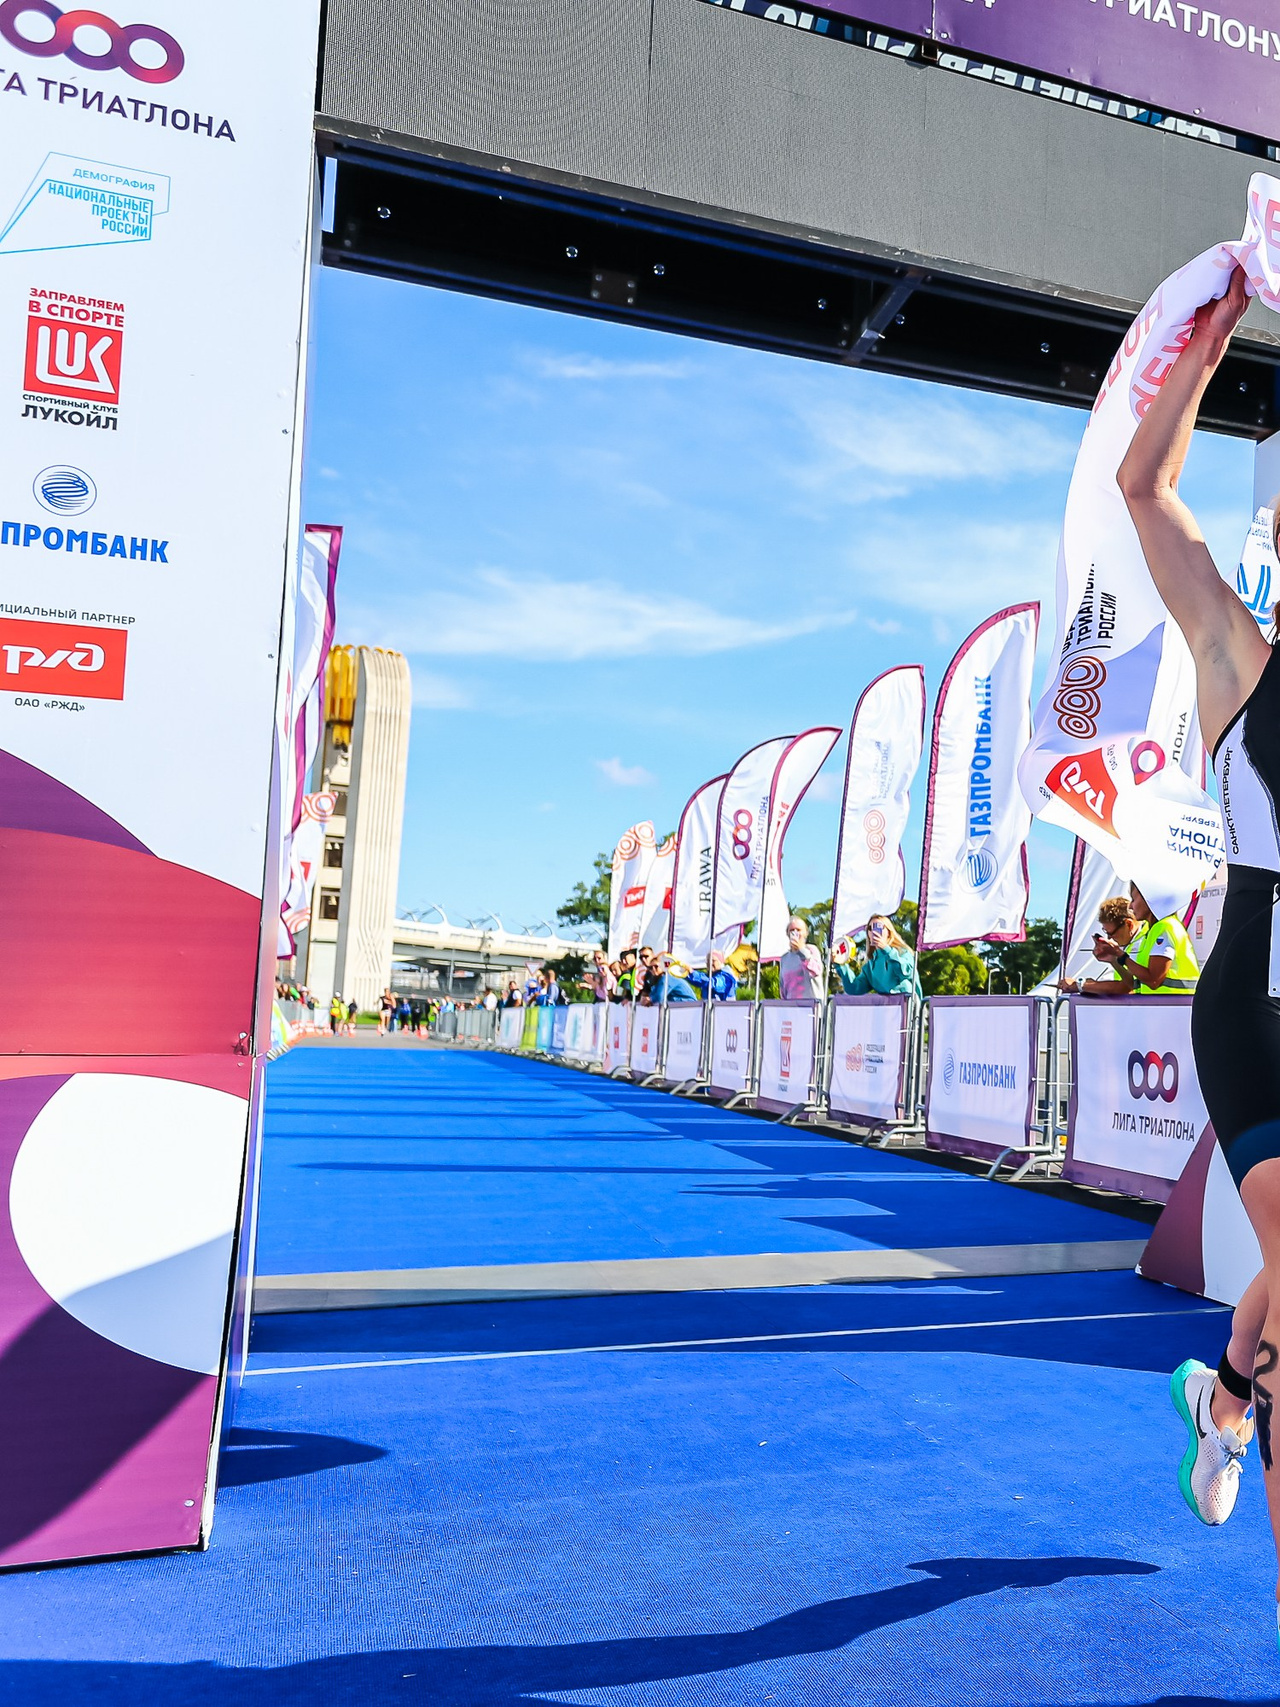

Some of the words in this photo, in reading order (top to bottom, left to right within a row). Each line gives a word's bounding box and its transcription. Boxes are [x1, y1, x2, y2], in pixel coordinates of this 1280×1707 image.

[37, 77, 237, 143] ТРИАТЛОНА
[72, 168, 156, 192] ДЕМОГРАФИЯ
[48, 183, 150, 213] НАЦИОНАЛЬНЫЕ
[91, 204, 149, 226] ПРОЕКТЫ
[101, 218, 148, 239] РОССИИ
[28, 300, 42, 314] В
[46, 306, 125, 329] СПОРТЕ
[29, 287, 125, 313] ЗАПРАВЛЯЕМ
[21, 403, 118, 431] ЛУКОЙЛ
[22, 393, 90, 409] СПОРТИВНЫЙ
[92, 403, 119, 414] КЛУБ
[81, 612, 136, 625] ПАРТНЕР
[1097, 591, 1117, 639] РОССИИ
[14, 697, 40, 708] ОАО
[44, 700, 85, 712] «РЖД»
[1172, 711, 1188, 763] ЛОНА
[969, 675, 992, 838] ГАЗПРОМБАНК
[1222, 747, 1240, 855] САНКТ-ПЕТЕРБУРГ
[1167, 839, 1225, 869] РАЦИЯ
[699, 846, 712, 917] TRAWA
[958, 1061, 1016, 1089] ГАЗПРОМБАНК
[1112, 1111, 1137, 1132] ЛИГА
[1139, 1114, 1195, 1142] ТРИАТЛОНА
